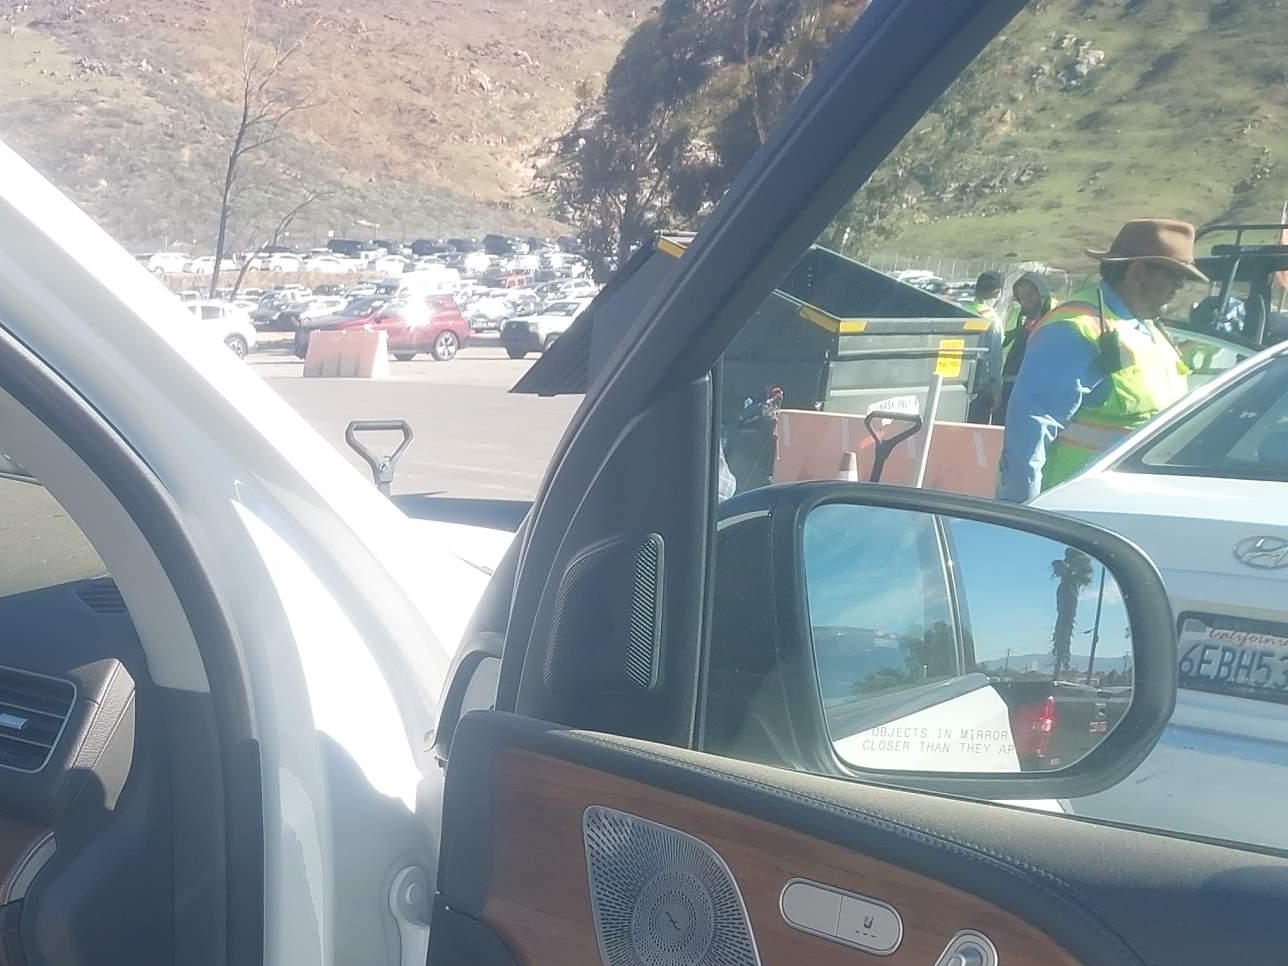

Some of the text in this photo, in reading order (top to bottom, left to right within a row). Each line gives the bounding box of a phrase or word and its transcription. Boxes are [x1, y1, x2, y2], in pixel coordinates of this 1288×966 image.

[872, 726, 1008, 741] OBJECTS IN MIRROR
[862, 739, 910, 752] CLOSER
[920, 741, 951, 753] THAN
[959, 742, 992, 754] THEY
